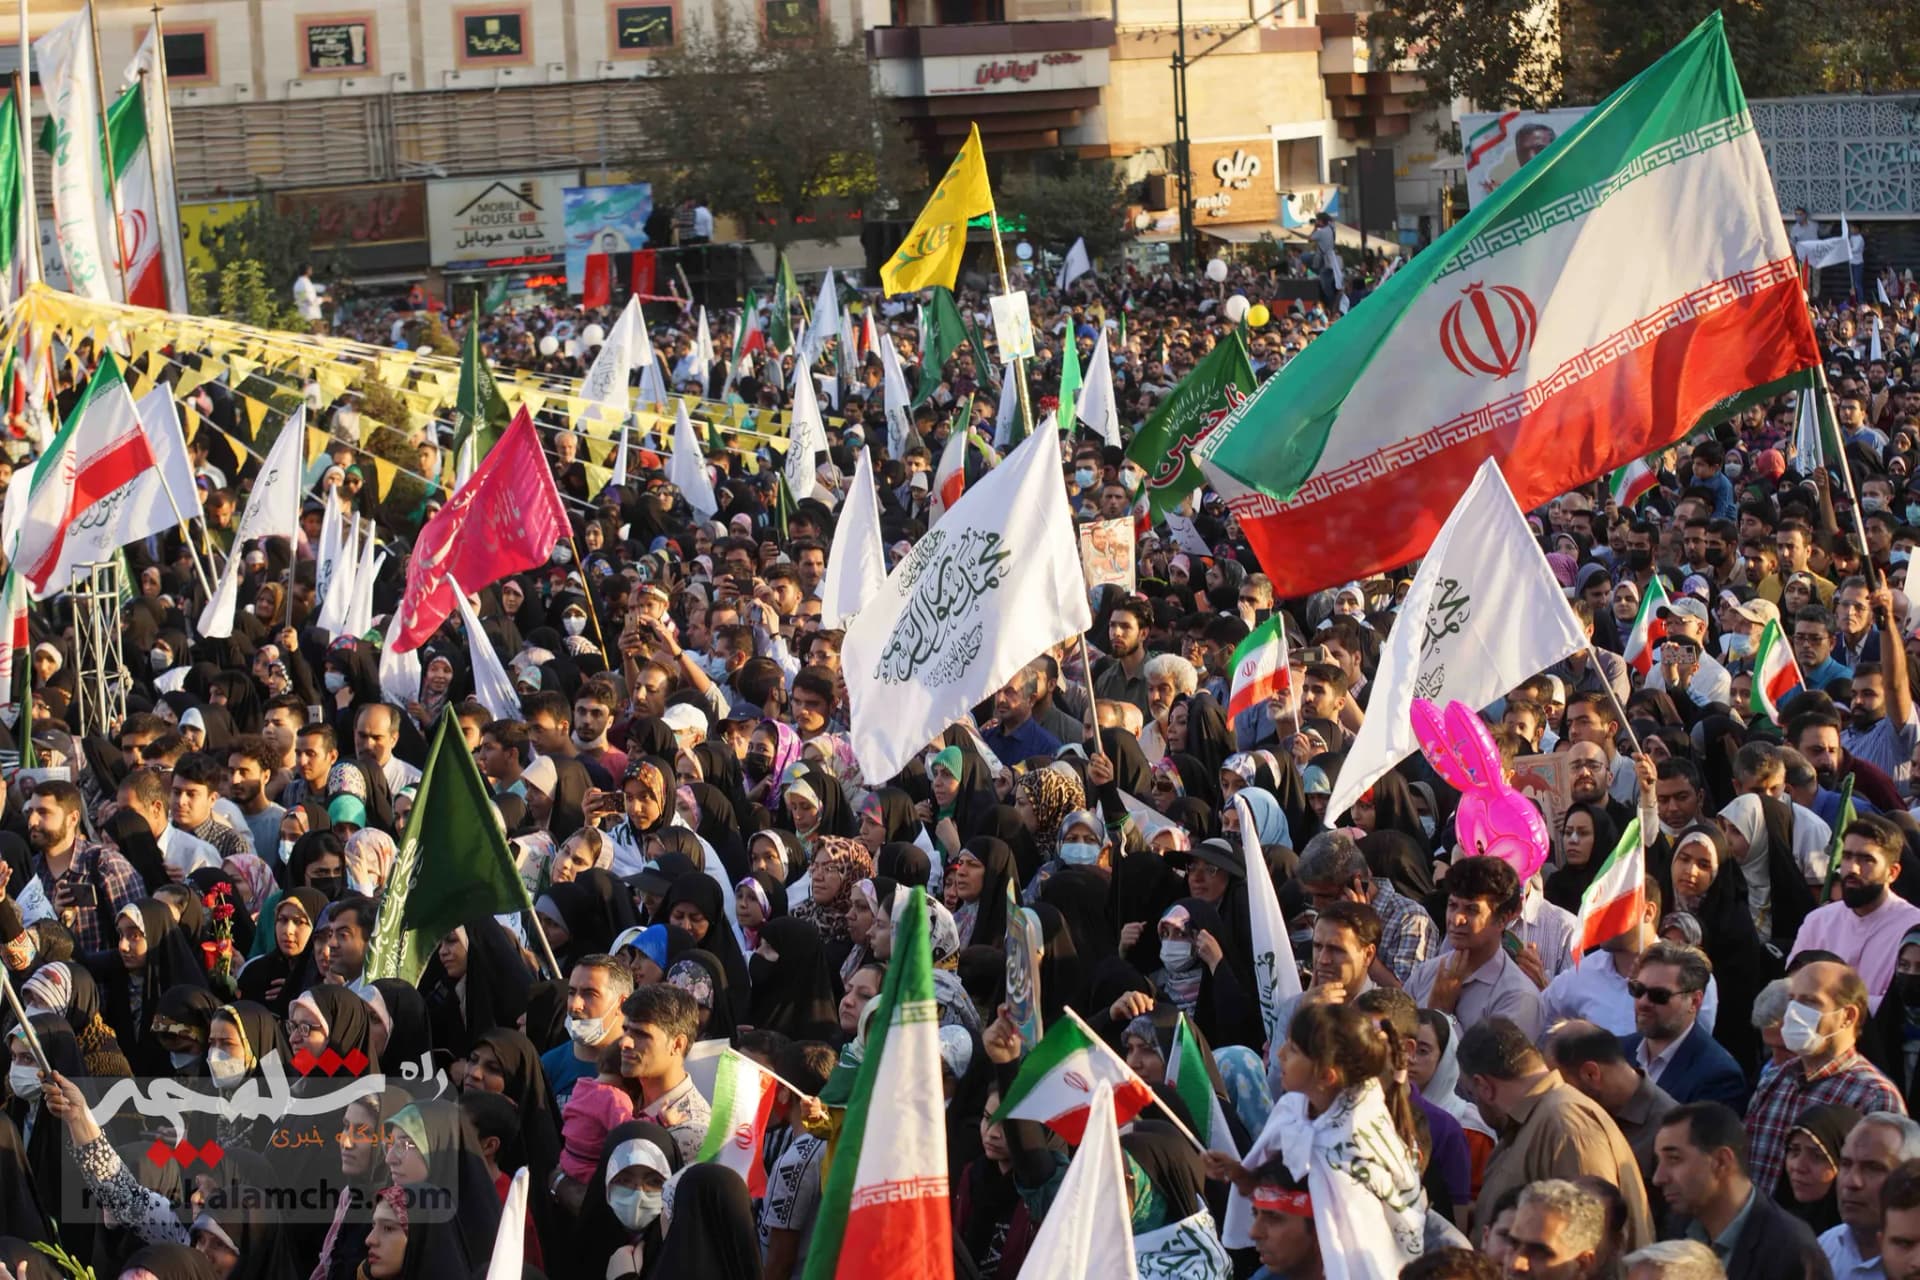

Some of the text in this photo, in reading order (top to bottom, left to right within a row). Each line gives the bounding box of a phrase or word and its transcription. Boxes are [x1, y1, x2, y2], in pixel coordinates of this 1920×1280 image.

[478, 201, 521, 213] MOBILE
[1195, 192, 1232, 209] melo
[470, 212, 515, 226] HOUSE
[456, 226, 545, 249] خانه موبایل
